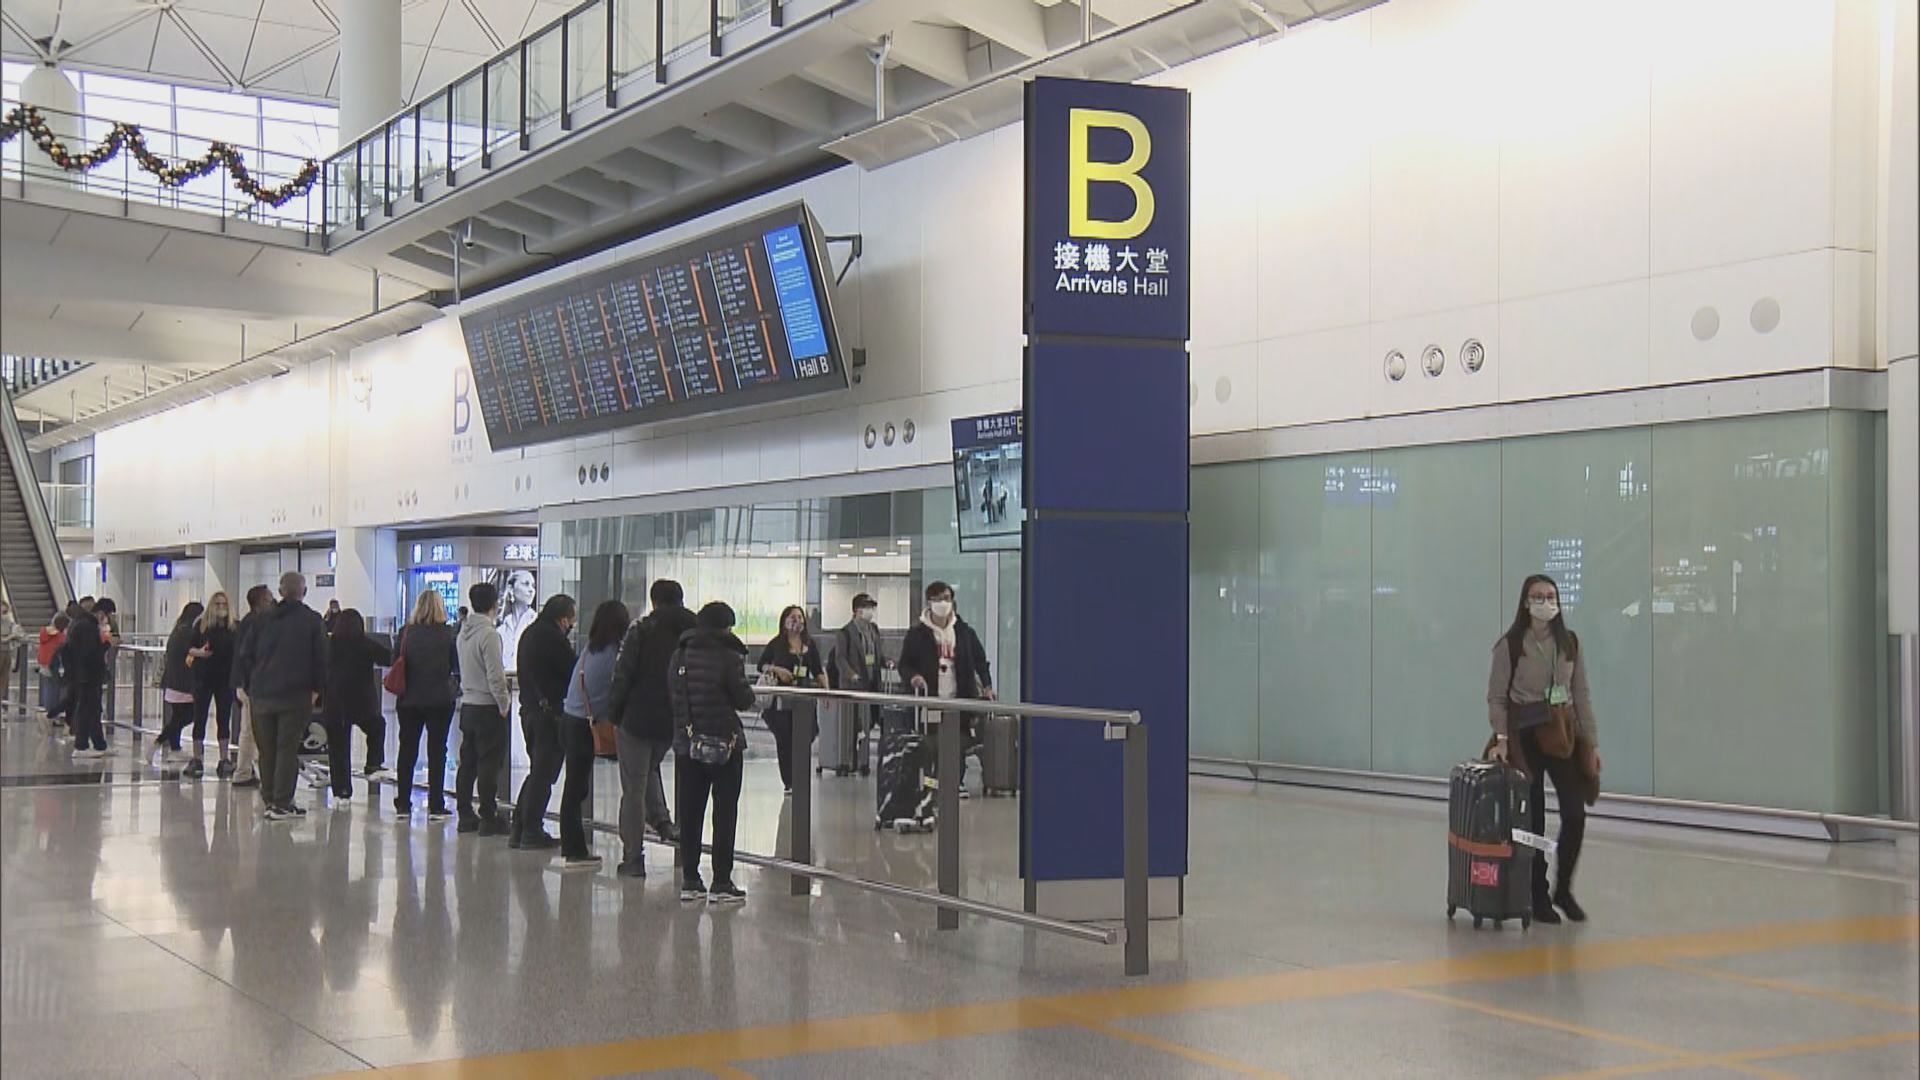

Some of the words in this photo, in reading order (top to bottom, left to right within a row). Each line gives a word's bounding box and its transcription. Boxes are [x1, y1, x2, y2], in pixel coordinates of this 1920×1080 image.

[1069, 108, 1156, 240] B
[1053, 241, 1170, 274] 接機大堂
[1055, 272, 1128, 295] Arrivals
[1133, 276, 1169, 297] Hall
[798, 358, 819, 379] Hall
[819, 355, 829, 374] B
